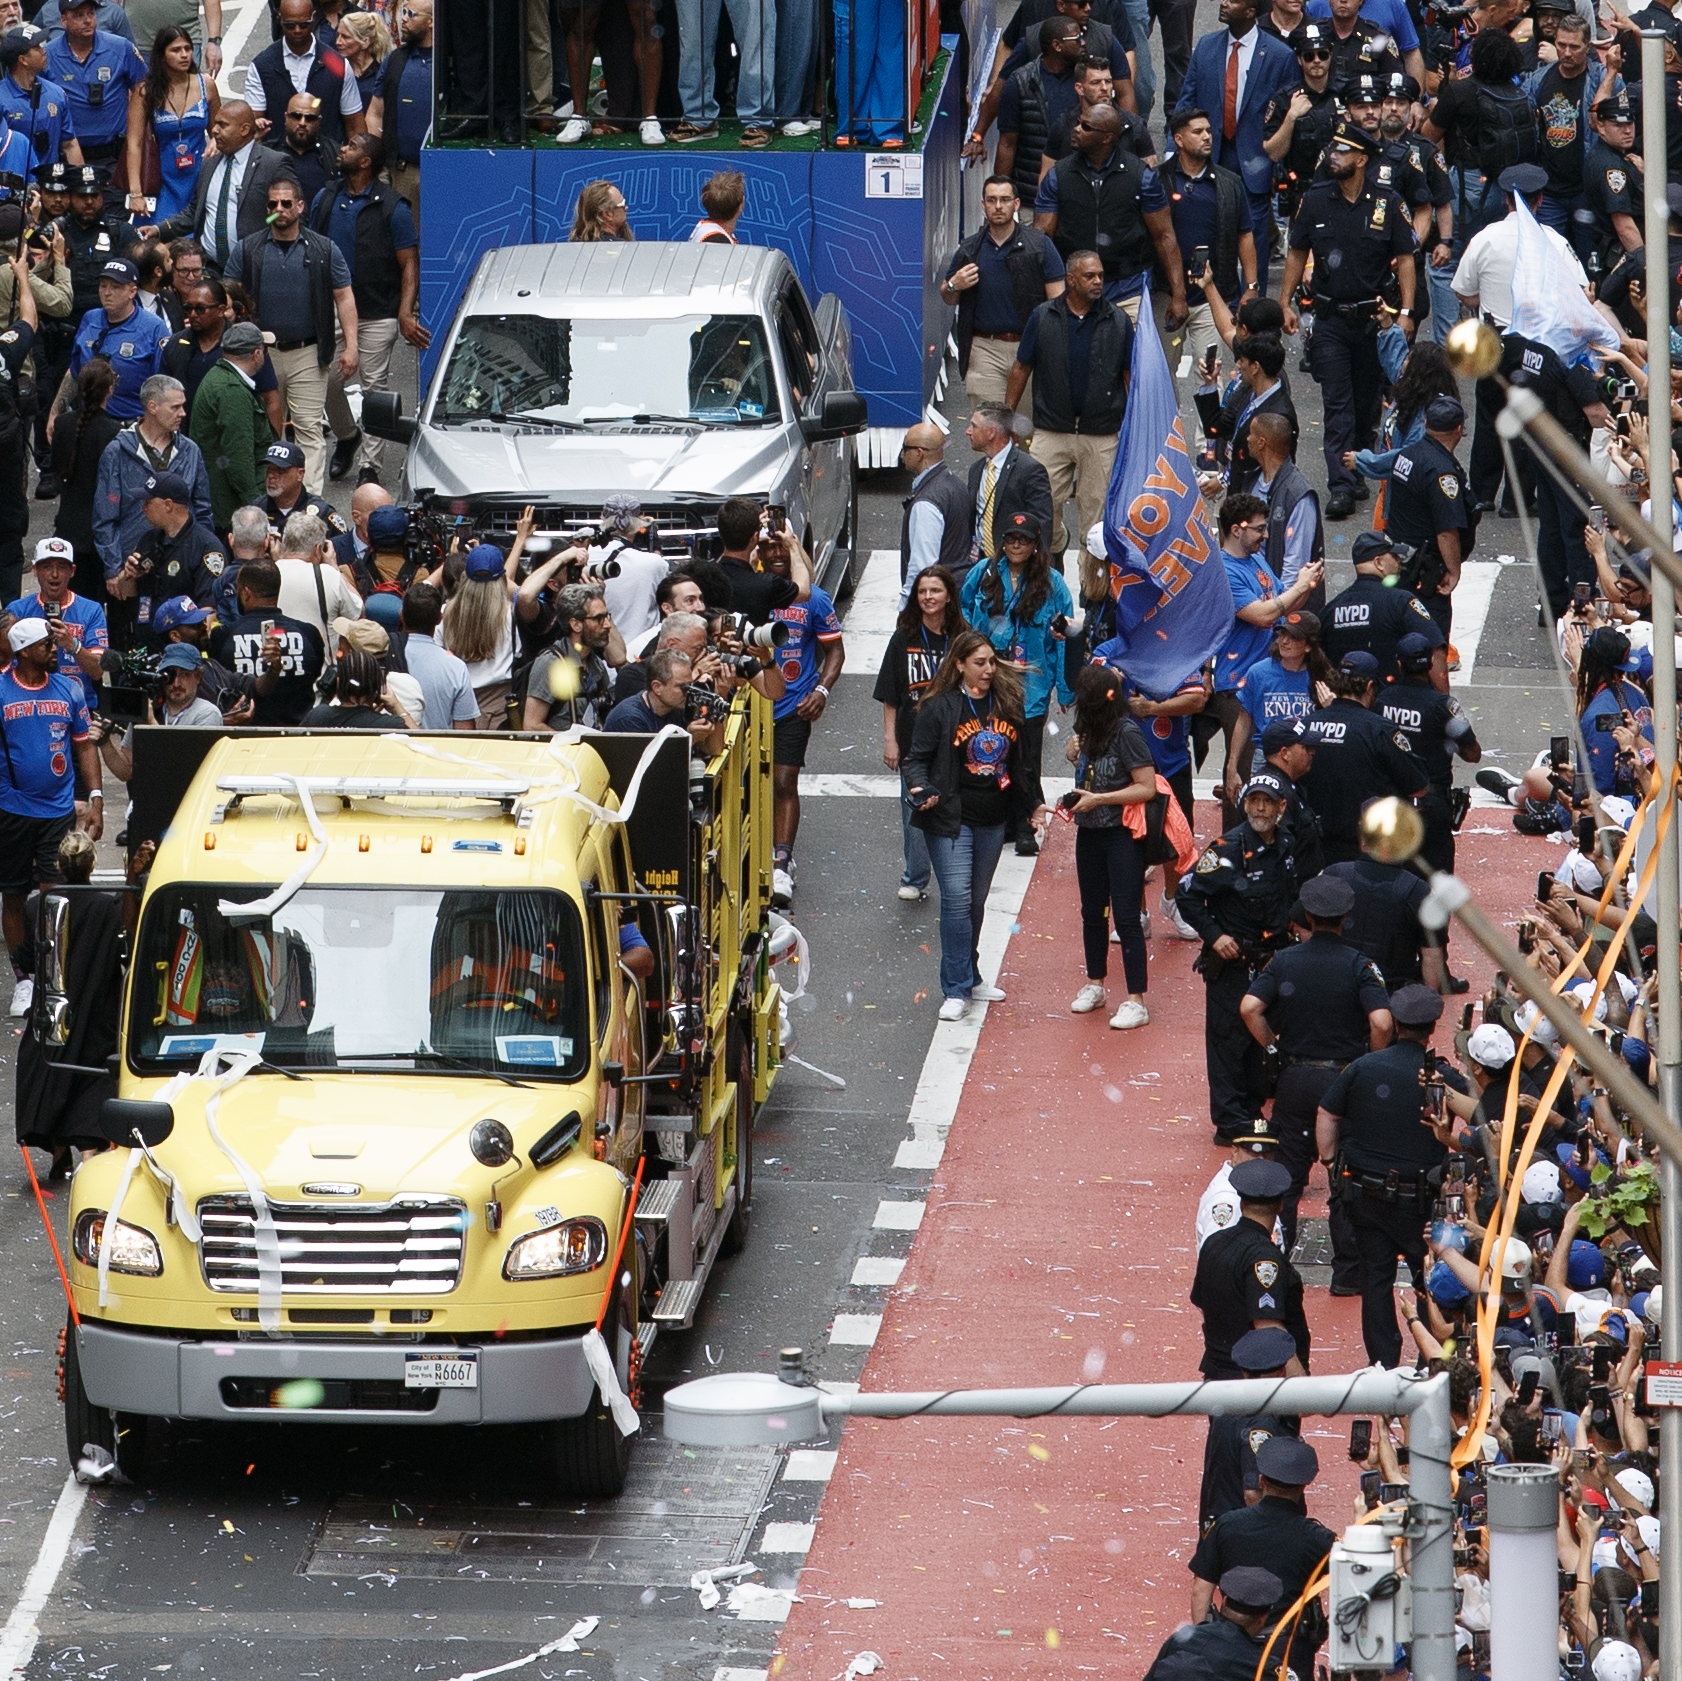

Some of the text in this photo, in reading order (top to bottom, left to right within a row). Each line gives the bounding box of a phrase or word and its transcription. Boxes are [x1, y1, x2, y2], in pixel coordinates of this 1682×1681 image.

[880, 171, 890, 194] 1
[1524, 349, 1546, 369] NYPD
[1394, 454, 1414, 475] NYPD
[1334, 604, 1370, 623] NYPD
[4, 699, 70, 722] NEW YORK
[1383, 705, 1422, 727] NYPD
[1249, 775, 1280, 789] NYPD
[443, 1363, 472, 1381] 6667
[1659, 1368, 1682, 1377] NOTICE
